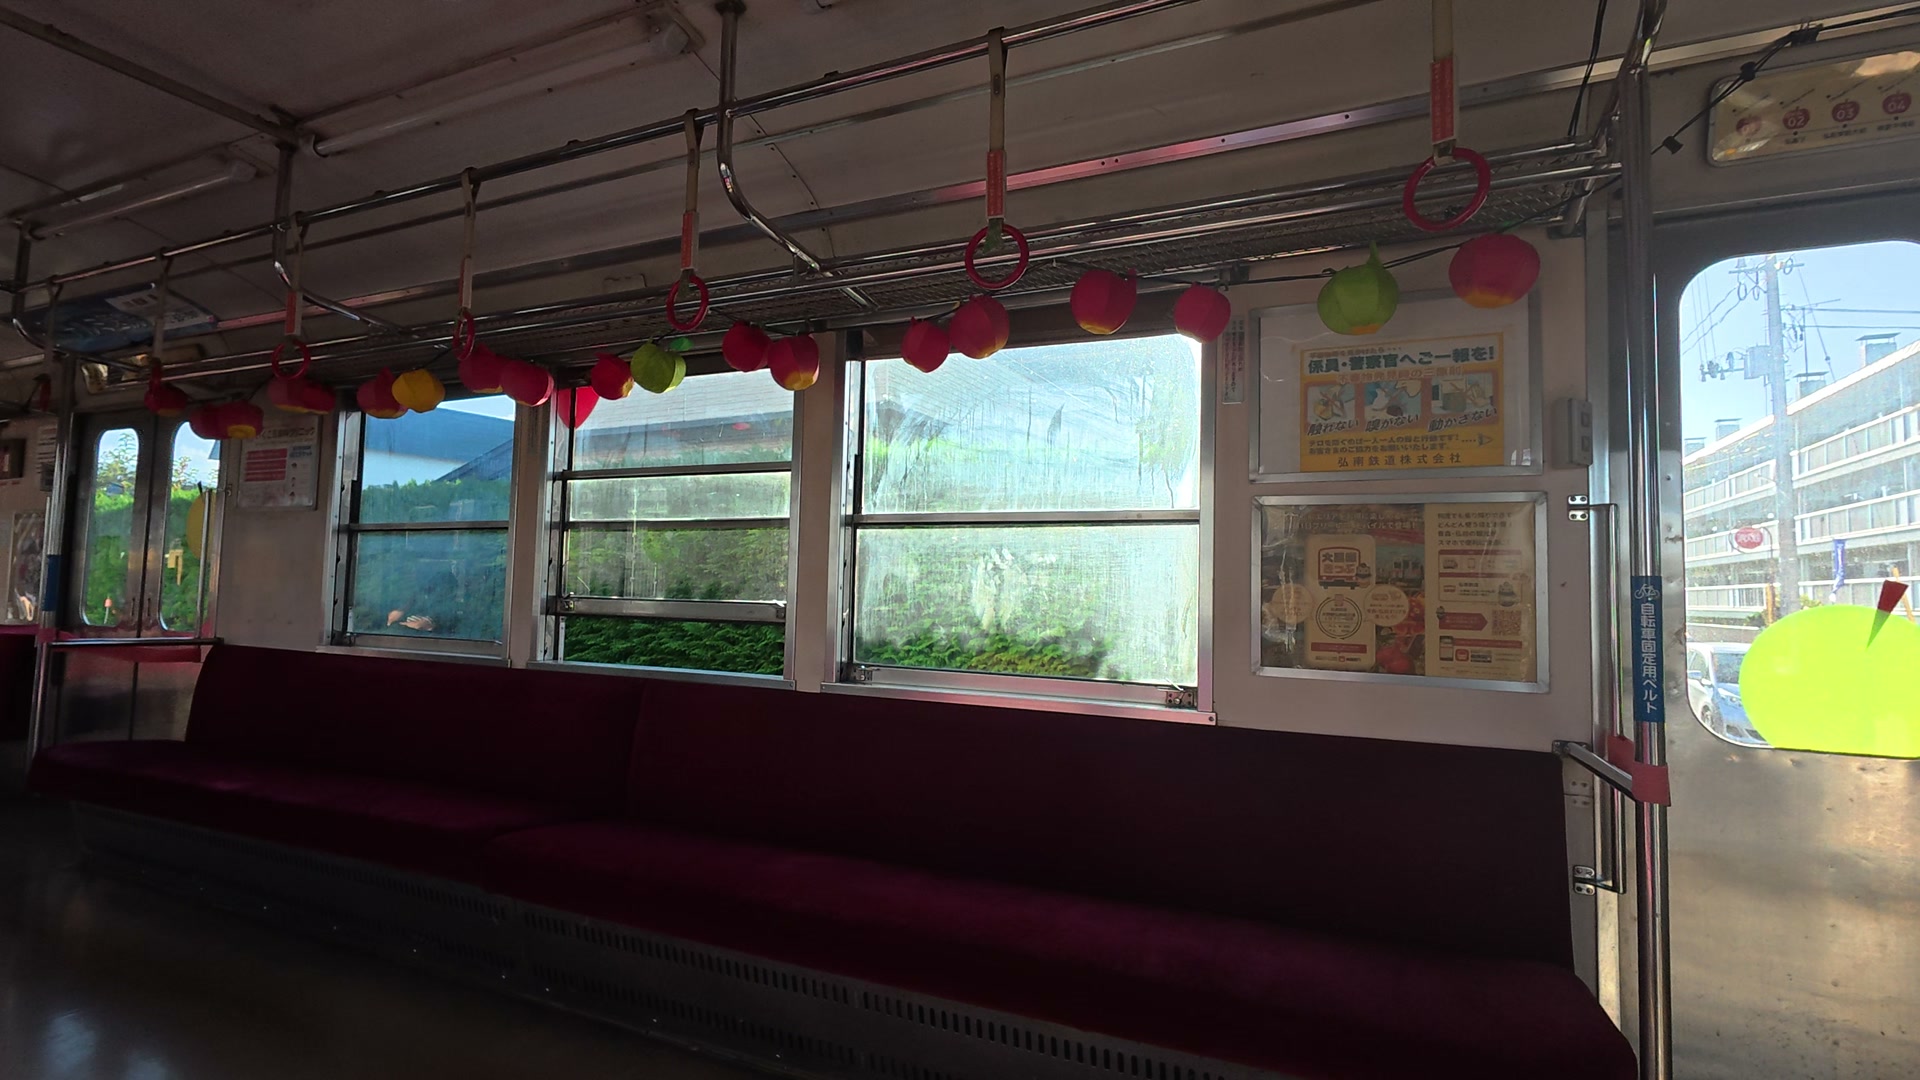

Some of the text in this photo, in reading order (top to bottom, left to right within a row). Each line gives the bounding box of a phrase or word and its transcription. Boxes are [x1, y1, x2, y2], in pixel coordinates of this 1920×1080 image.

[1787, 116, 1805, 127] 02
[1837, 109, 1855, 121] 03
[1427, 408, 1497, 432] 動かさない
[1338, 452, 1461, 467] 弘南鉄道株式会社
[1640, 602, 1658, 713] 自転車固定用ベルト
